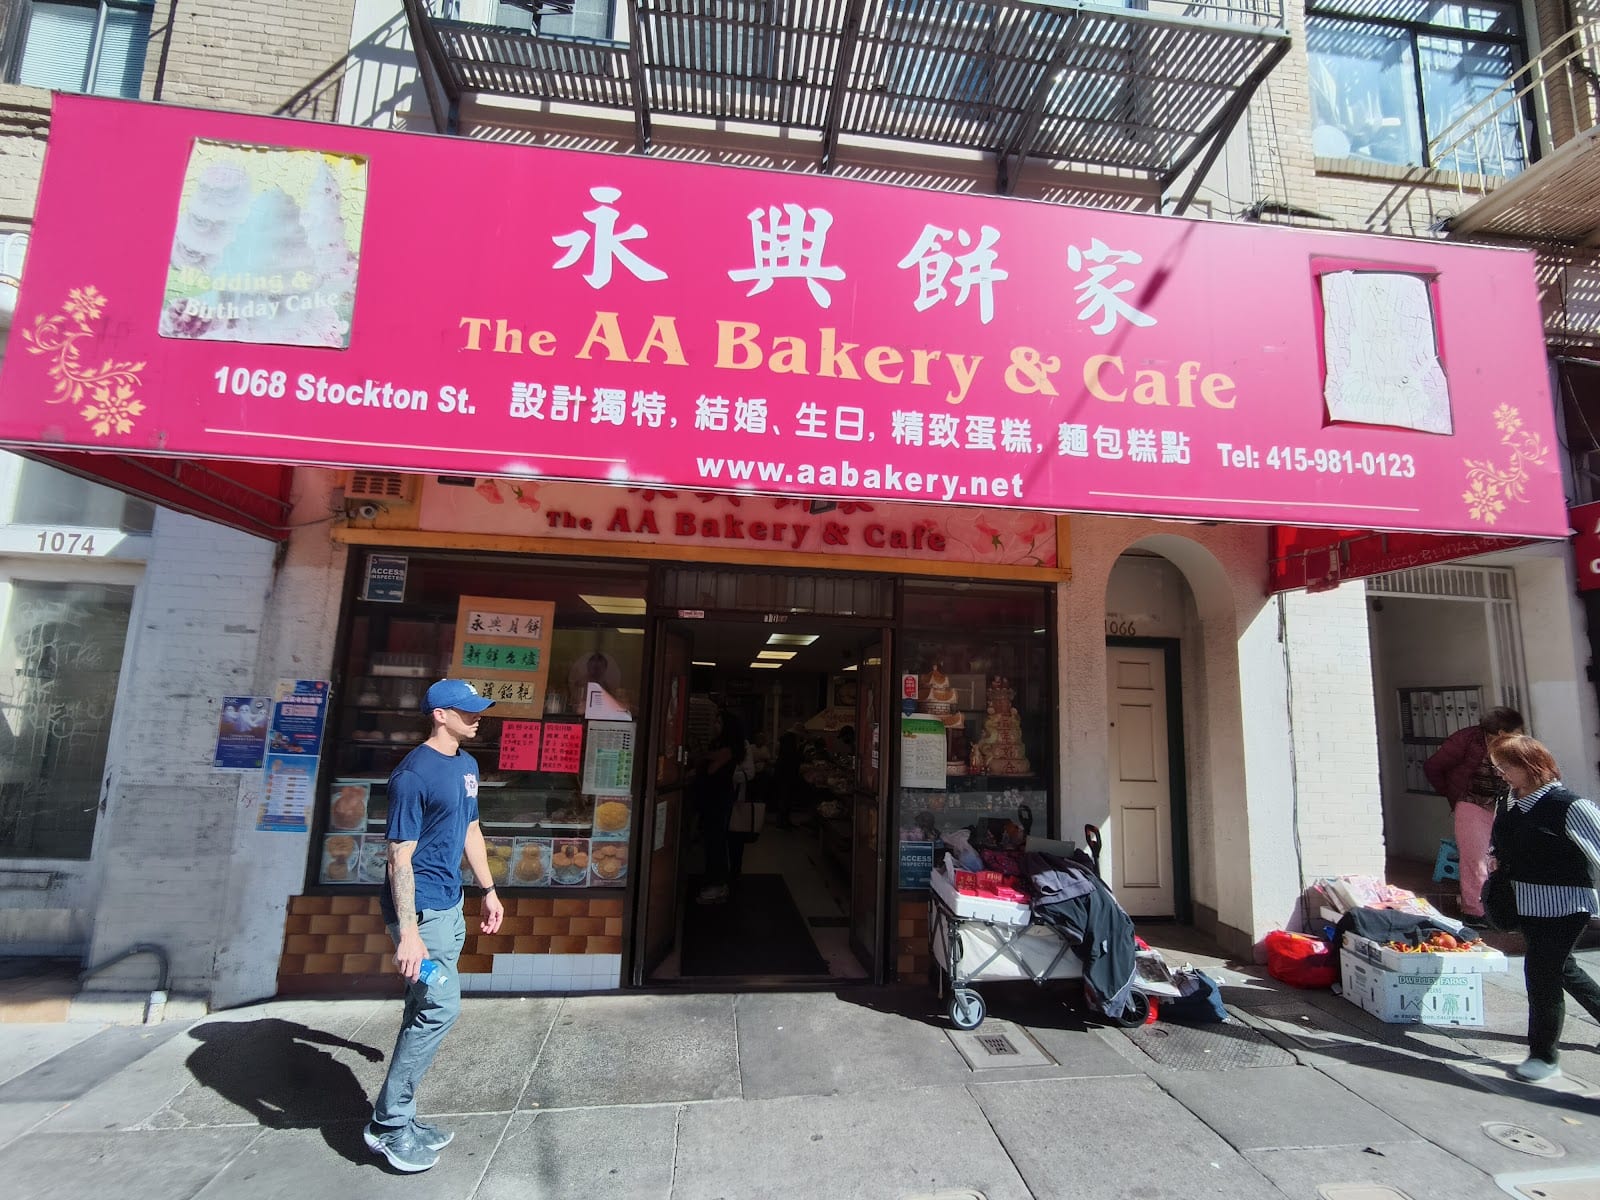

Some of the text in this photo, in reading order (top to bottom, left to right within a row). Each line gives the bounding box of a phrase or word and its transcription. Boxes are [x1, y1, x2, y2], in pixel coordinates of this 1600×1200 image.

[552, 186, 1157, 335] 永興餅家
[180, 267, 315, 293] Wedding &
[185, 292, 338, 320] Birthday Cake
[458, 311, 1237, 409] The AA Bakery & Cafe
[214, 366, 477, 414] 1068 Stockton St.
[1217, 442, 1416, 478] Tel: 415-981-0123
[697, 456, 1023, 501] www.aabakery.net
[36, 531, 94, 555] 1074
[546, 508, 946, 551] The AA Bakery & Cafe
[371, 568, 405, 576] ACCESS
[1440, 977, 1468, 986] FARMS
